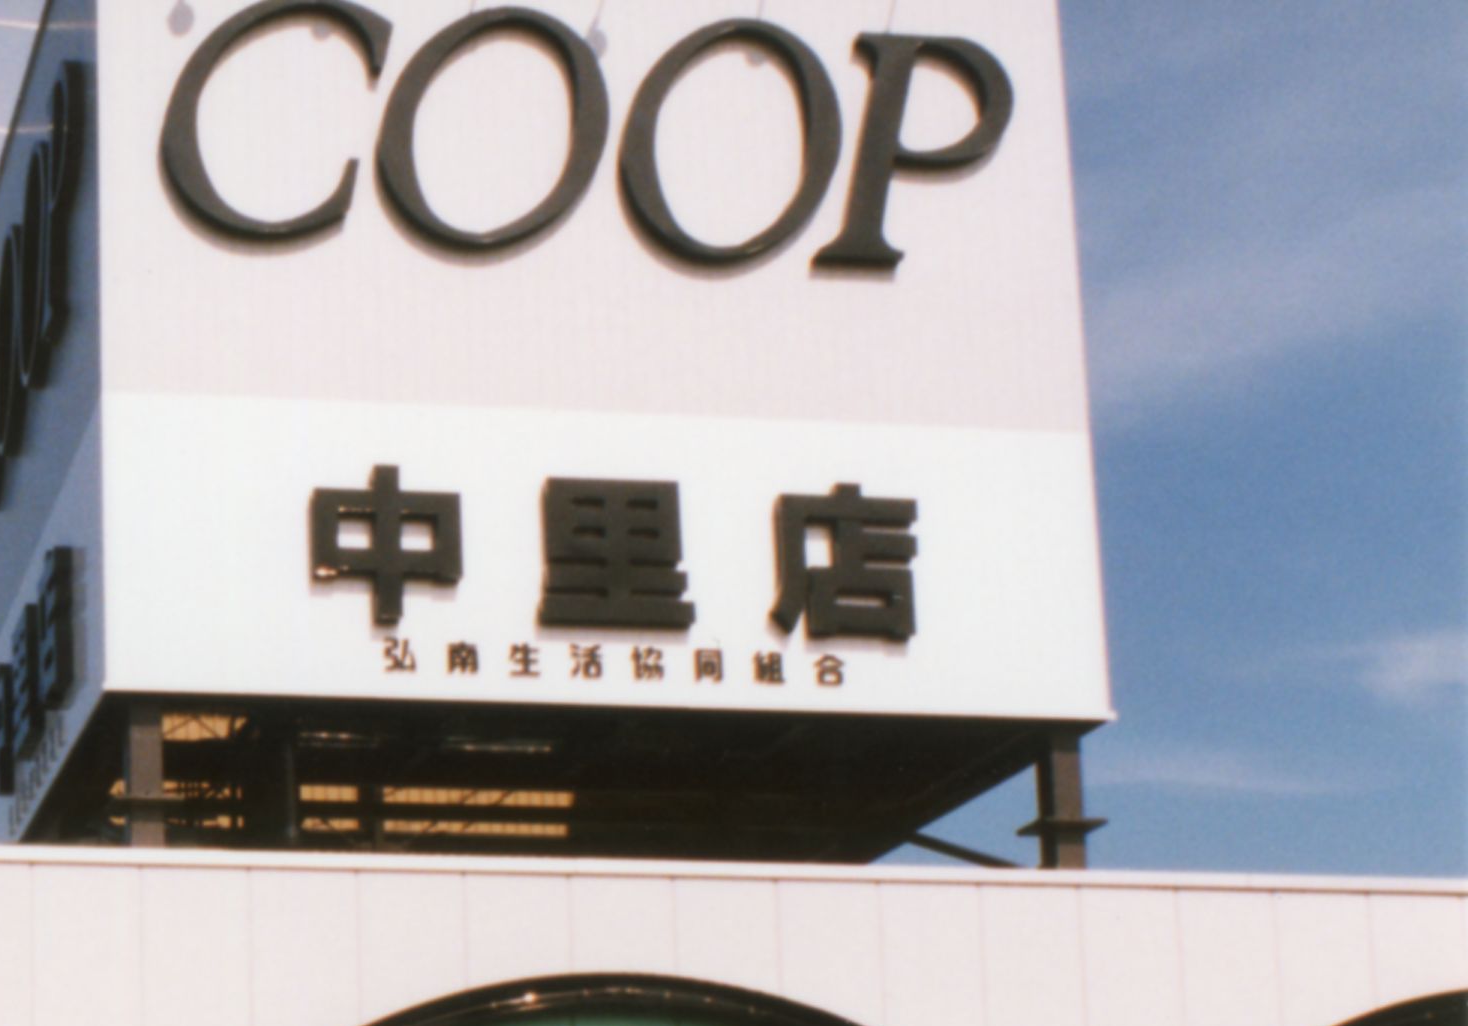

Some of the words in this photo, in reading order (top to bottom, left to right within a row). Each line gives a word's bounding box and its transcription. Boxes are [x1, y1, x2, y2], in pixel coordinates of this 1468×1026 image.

[158, 0, 1014, 277] COOP
[311, 464, 917, 643] 中里店
[382, 637, 846, 687] 弘南生活協同組合
